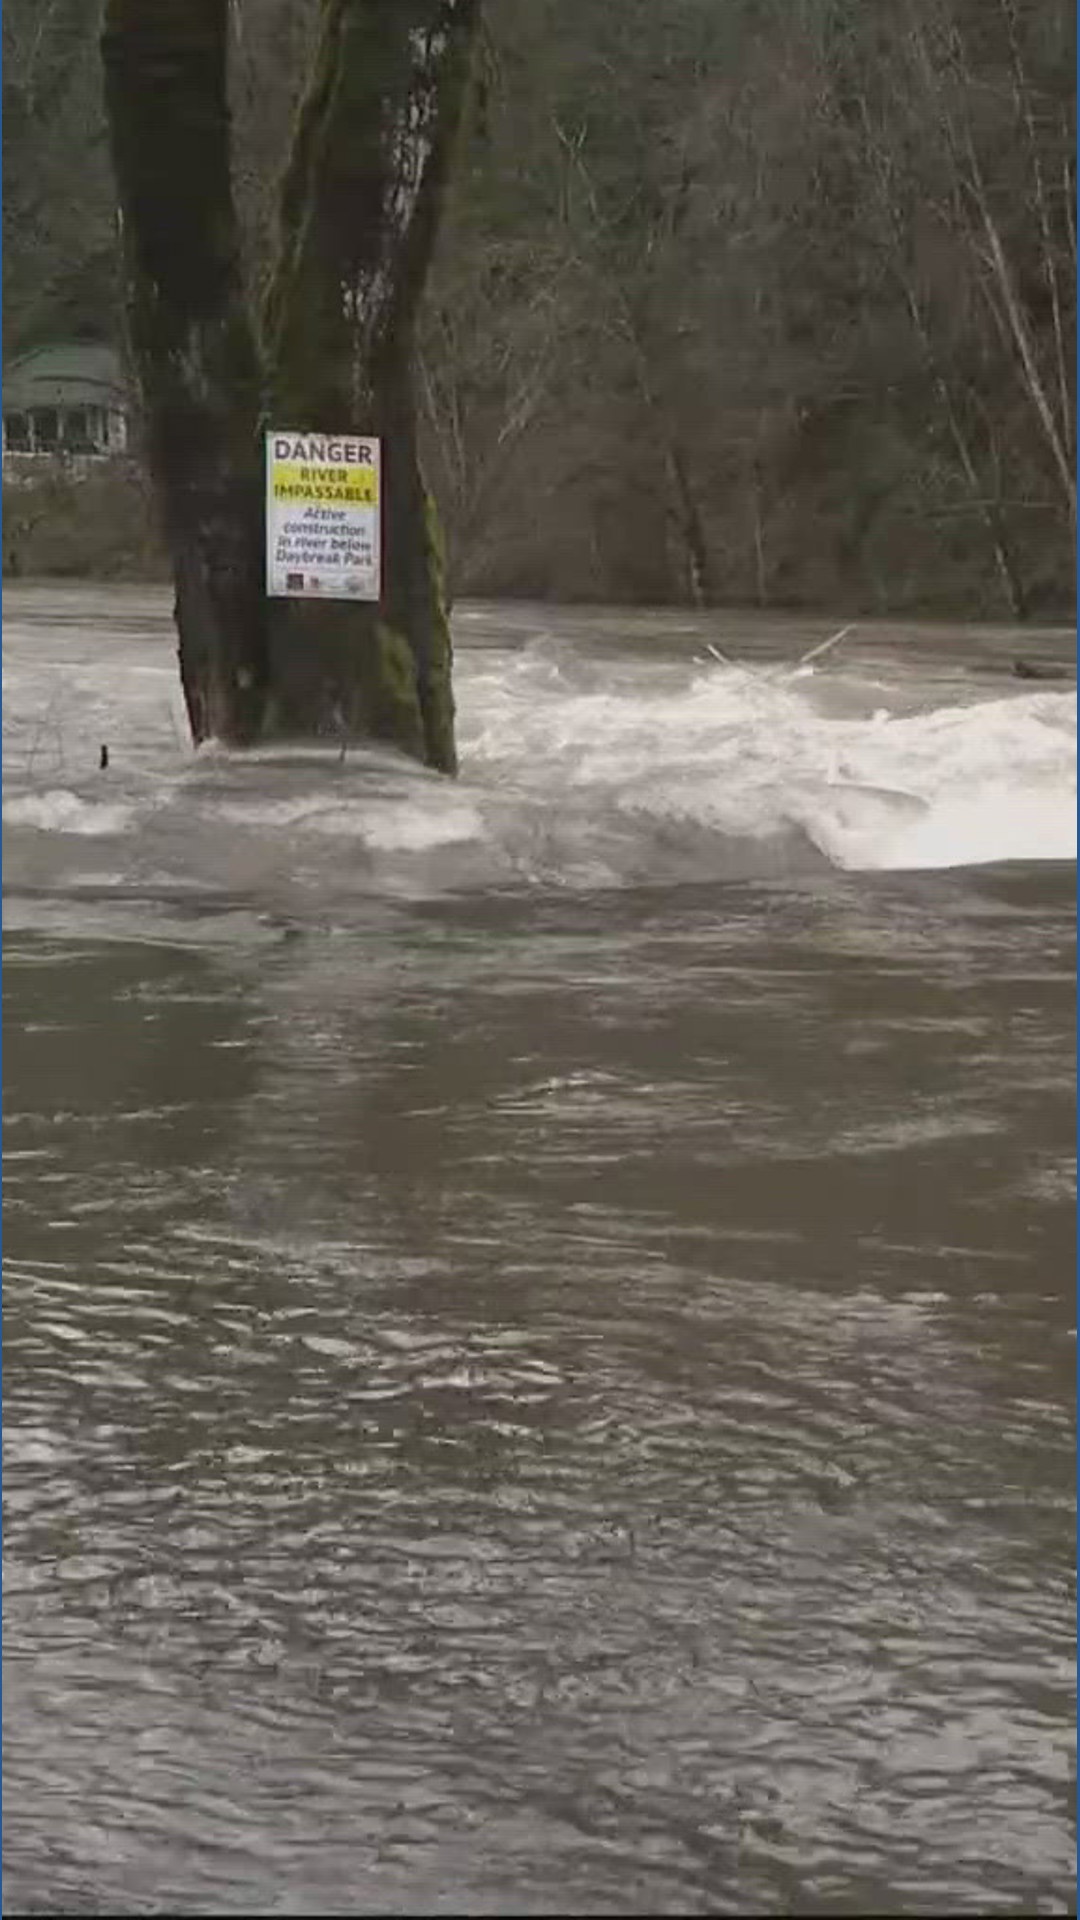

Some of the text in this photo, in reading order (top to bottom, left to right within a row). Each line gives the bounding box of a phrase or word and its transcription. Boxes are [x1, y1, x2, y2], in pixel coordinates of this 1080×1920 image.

[275, 439, 372, 465] DANGER
[300, 467, 349, 483] RIVER
[274, 484, 371, 501] IMPASSABLE
[303, 507, 347, 519] Active
[284, 522, 366, 536] construction
[278, 536, 371, 551] in river below
[276, 548, 340, 563] Daybreak
